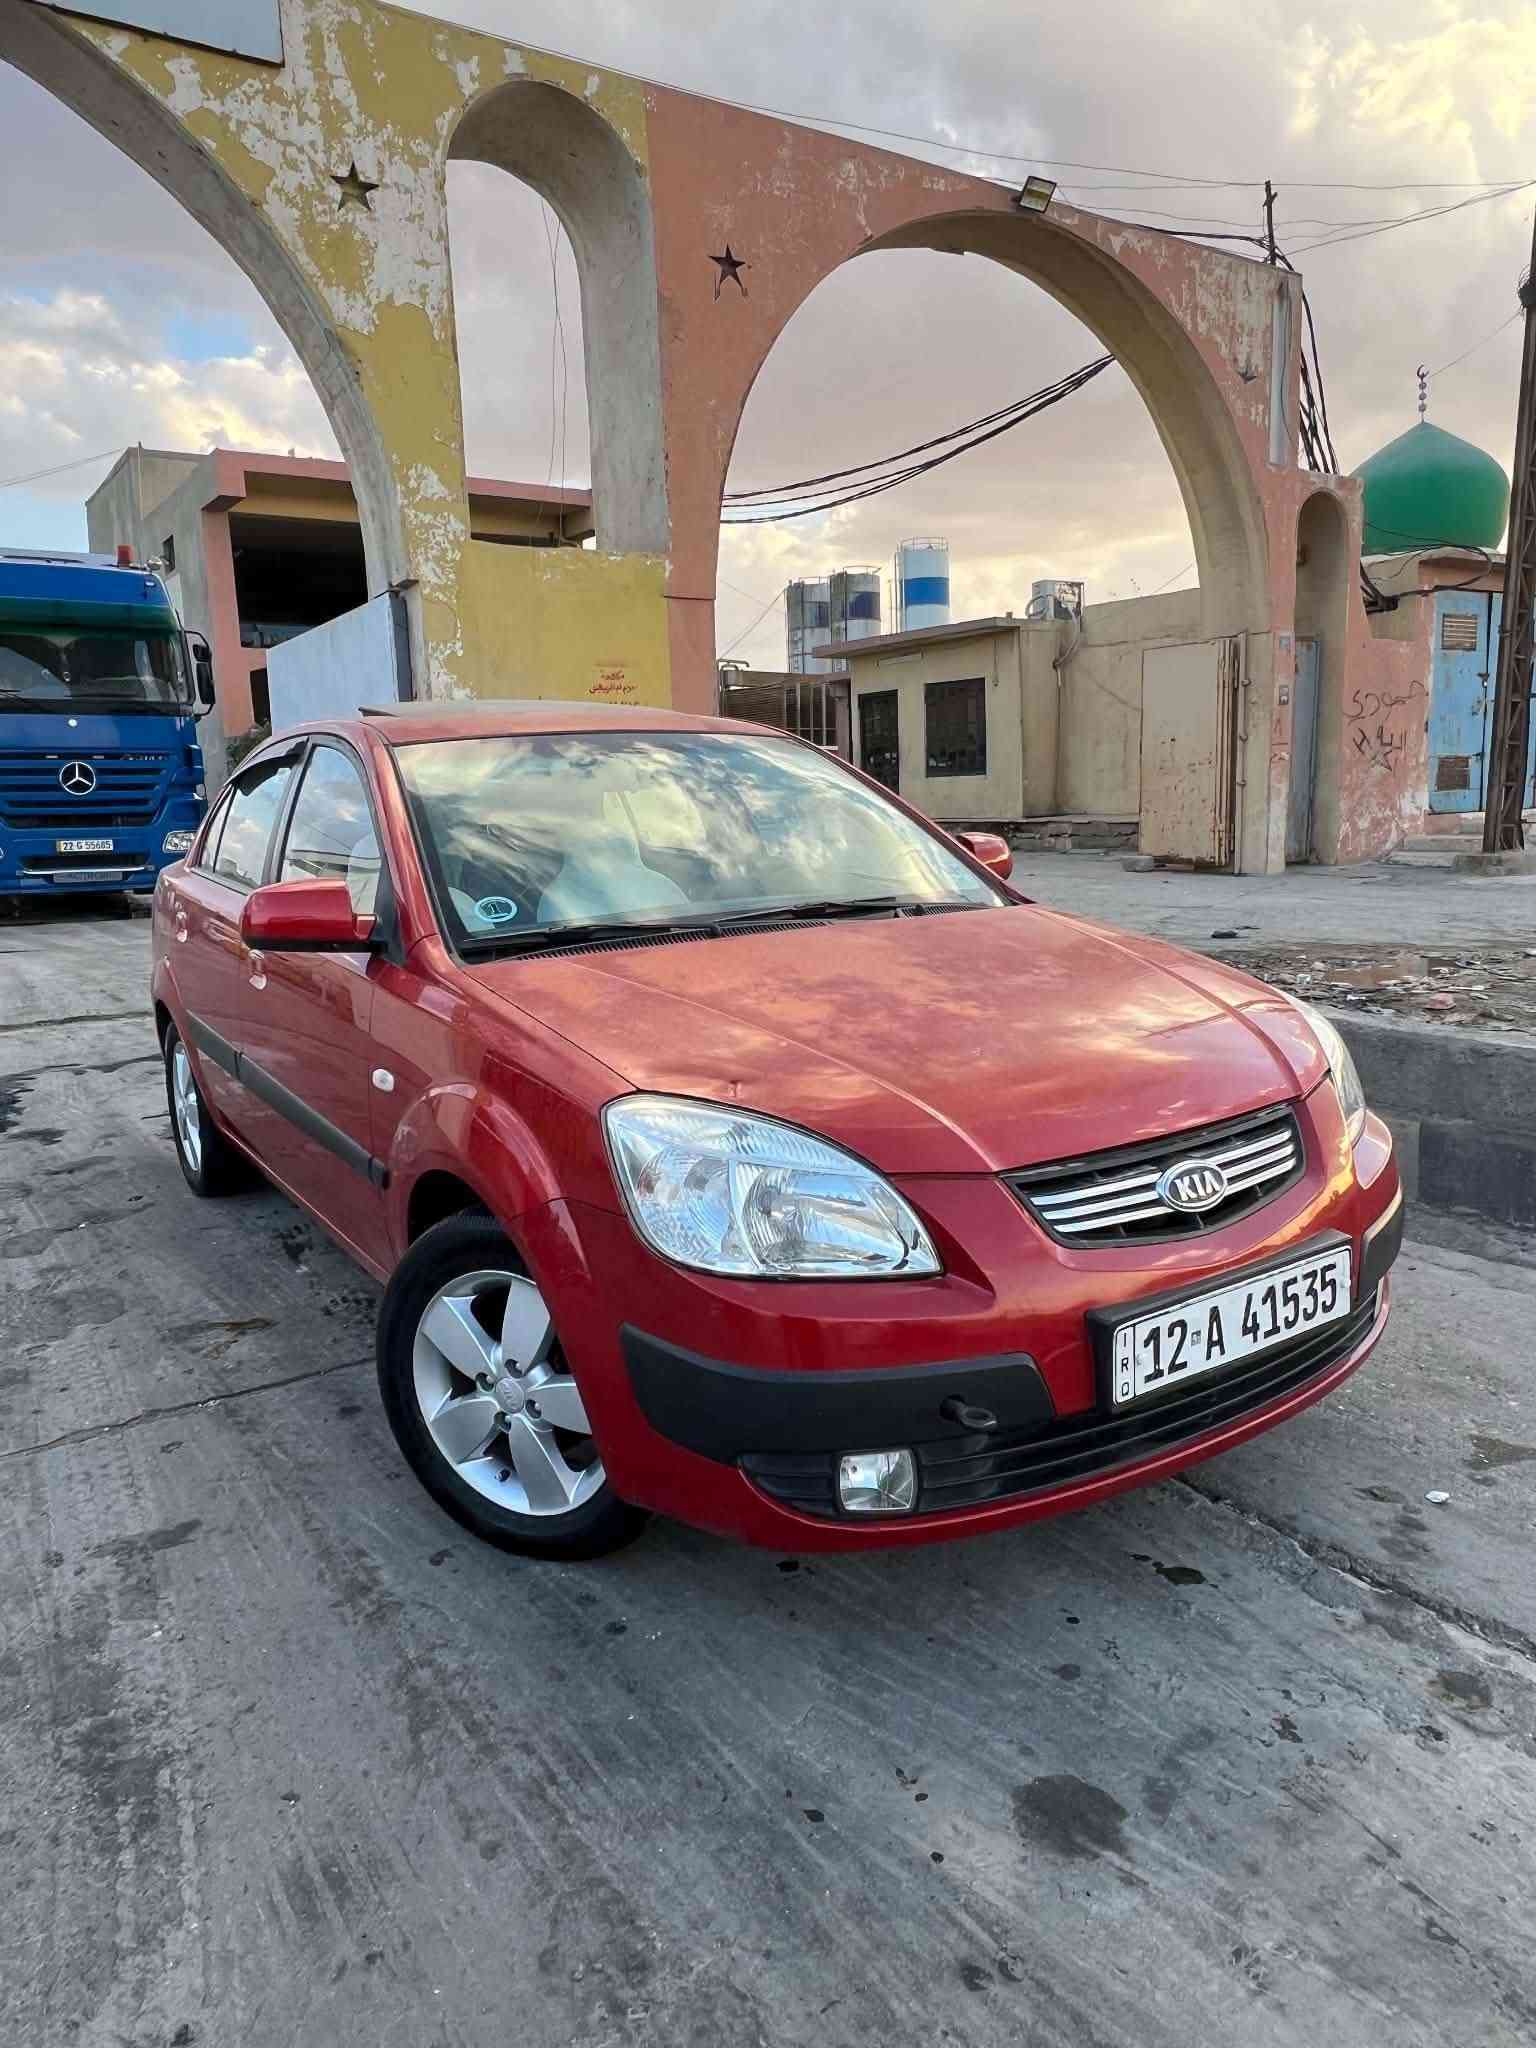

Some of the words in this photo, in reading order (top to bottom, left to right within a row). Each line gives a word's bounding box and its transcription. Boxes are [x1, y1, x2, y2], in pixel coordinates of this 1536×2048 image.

[63, 841, 73, 850] 22
[1174, 1171, 1221, 1201] KIA
[1143, 1319, 1188, 1384] 12
[1205, 1305, 1226, 1361] A
[1241, 1262, 1338, 1344] 41535
